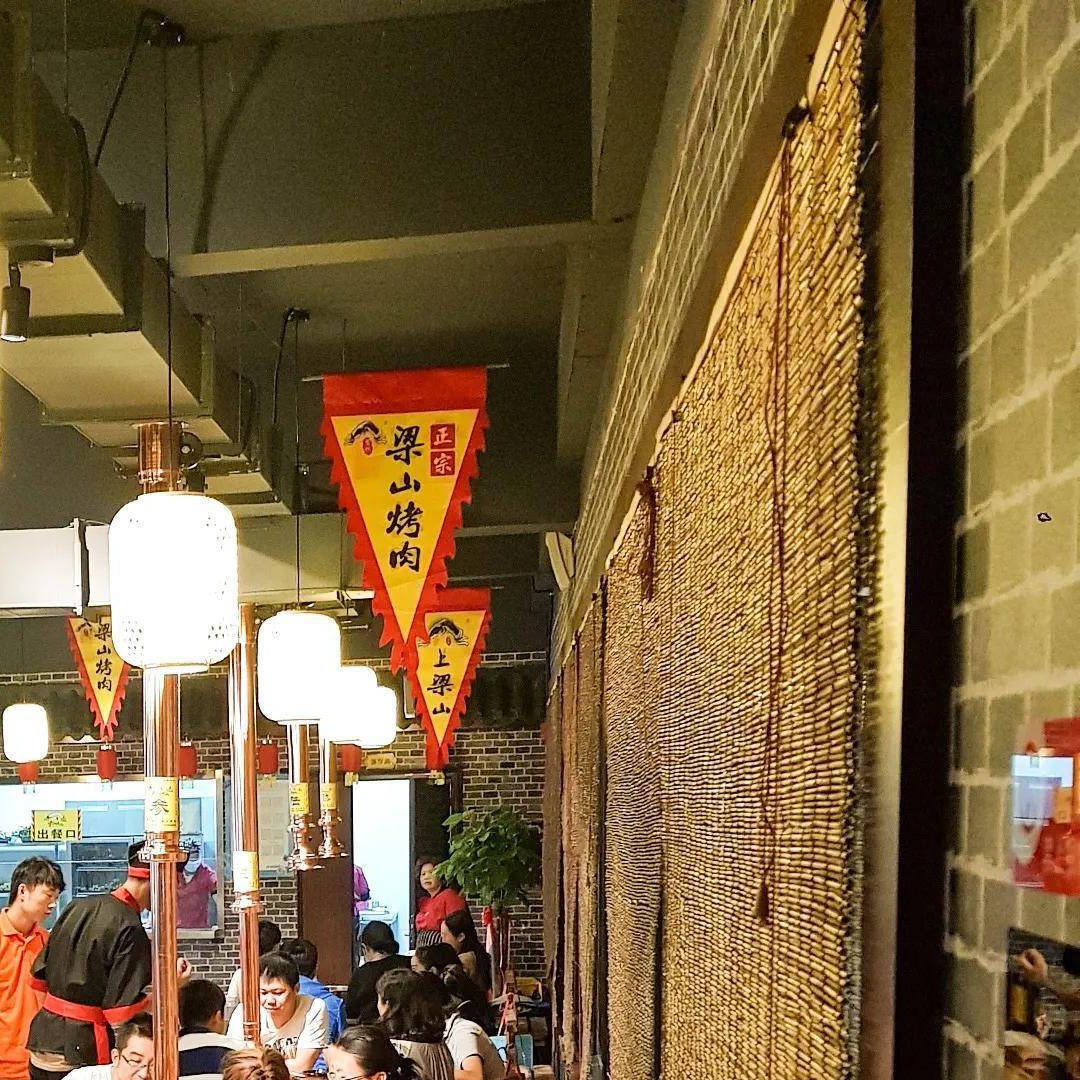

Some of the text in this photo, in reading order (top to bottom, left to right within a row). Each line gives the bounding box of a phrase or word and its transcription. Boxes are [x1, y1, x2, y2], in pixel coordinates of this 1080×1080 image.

[432, 426, 455, 475] 正宗
[385, 424, 425, 573] 梁山烤肉
[95, 623, 112, 692] 梁山烤肉
[427, 648, 454, 716] 上梁山
[37, 828, 76, 840] 出餐口
